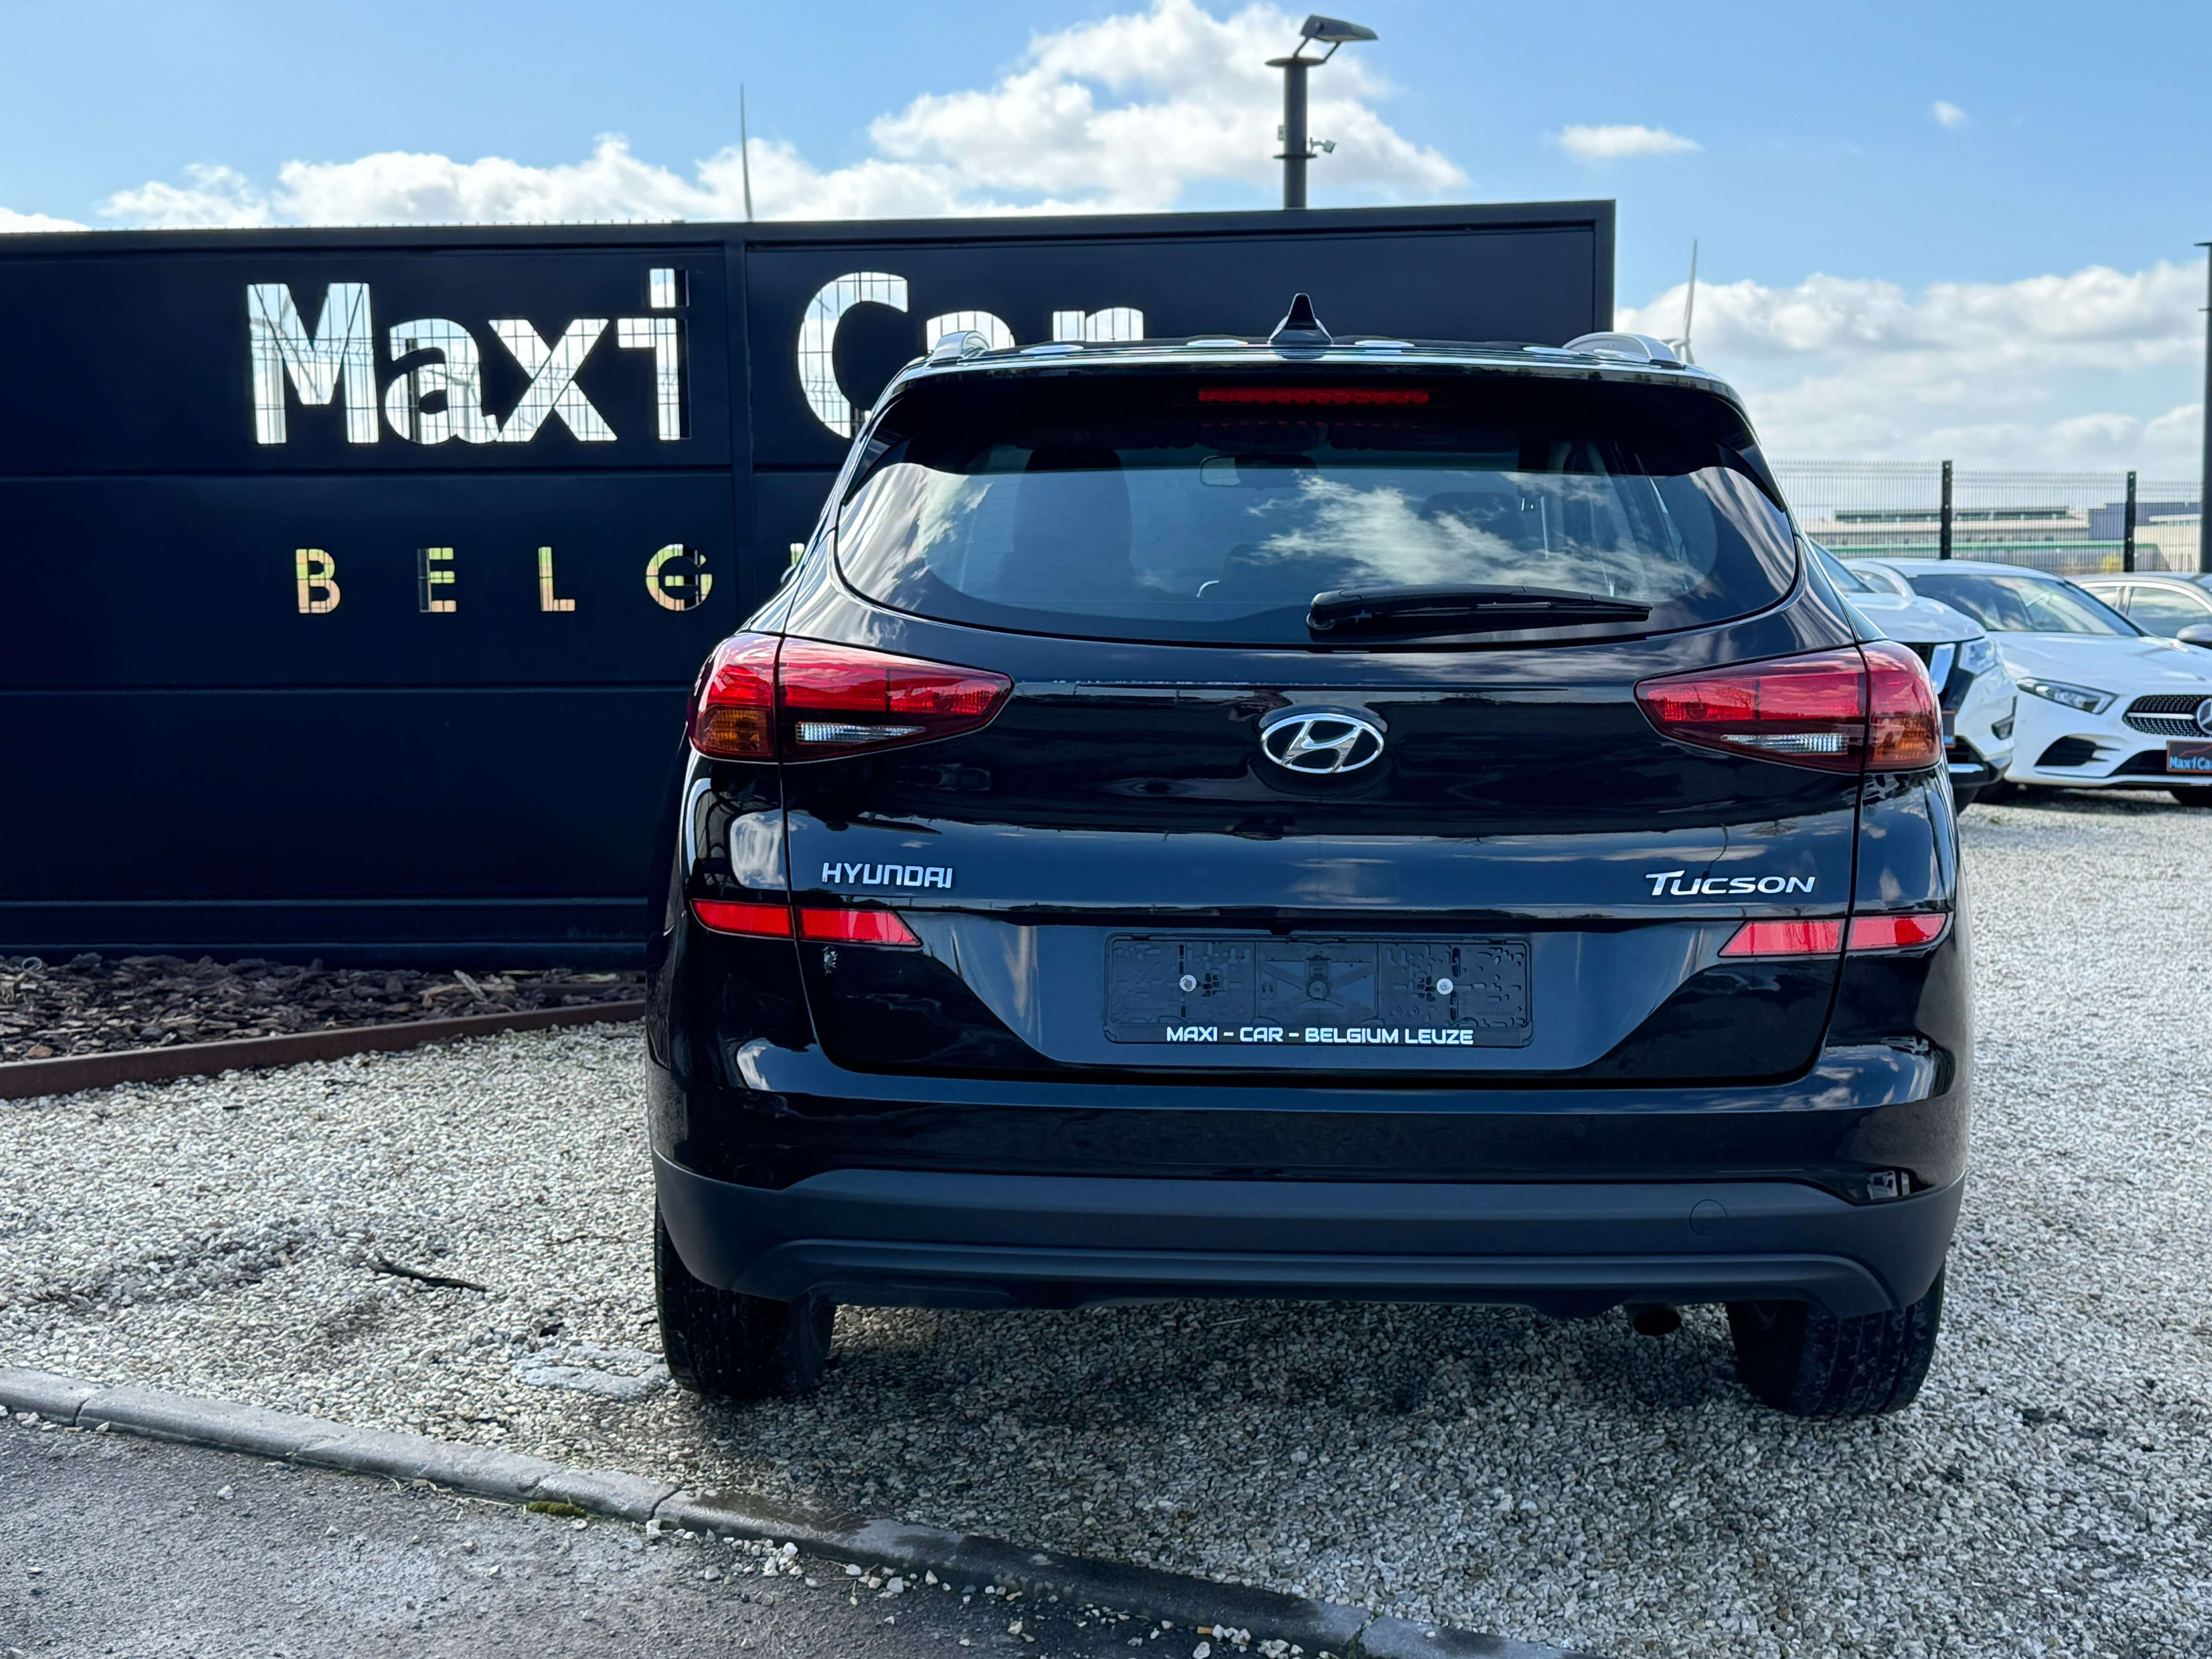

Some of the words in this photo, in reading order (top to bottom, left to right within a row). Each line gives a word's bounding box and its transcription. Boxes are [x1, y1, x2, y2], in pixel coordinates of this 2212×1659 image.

[247, 268, 692, 445] Maxi
[822, 862, 953, 888] HYUNDAI
[1645, 870, 1816, 896] TUCSON
[1166, 1026, 1218, 1042] MAXI
[1240, 1027, 1284, 1042] CAR
[1305, 1027, 1399, 1043] BELGIUM
[1405, 1029, 1474, 1045] LEUZE
